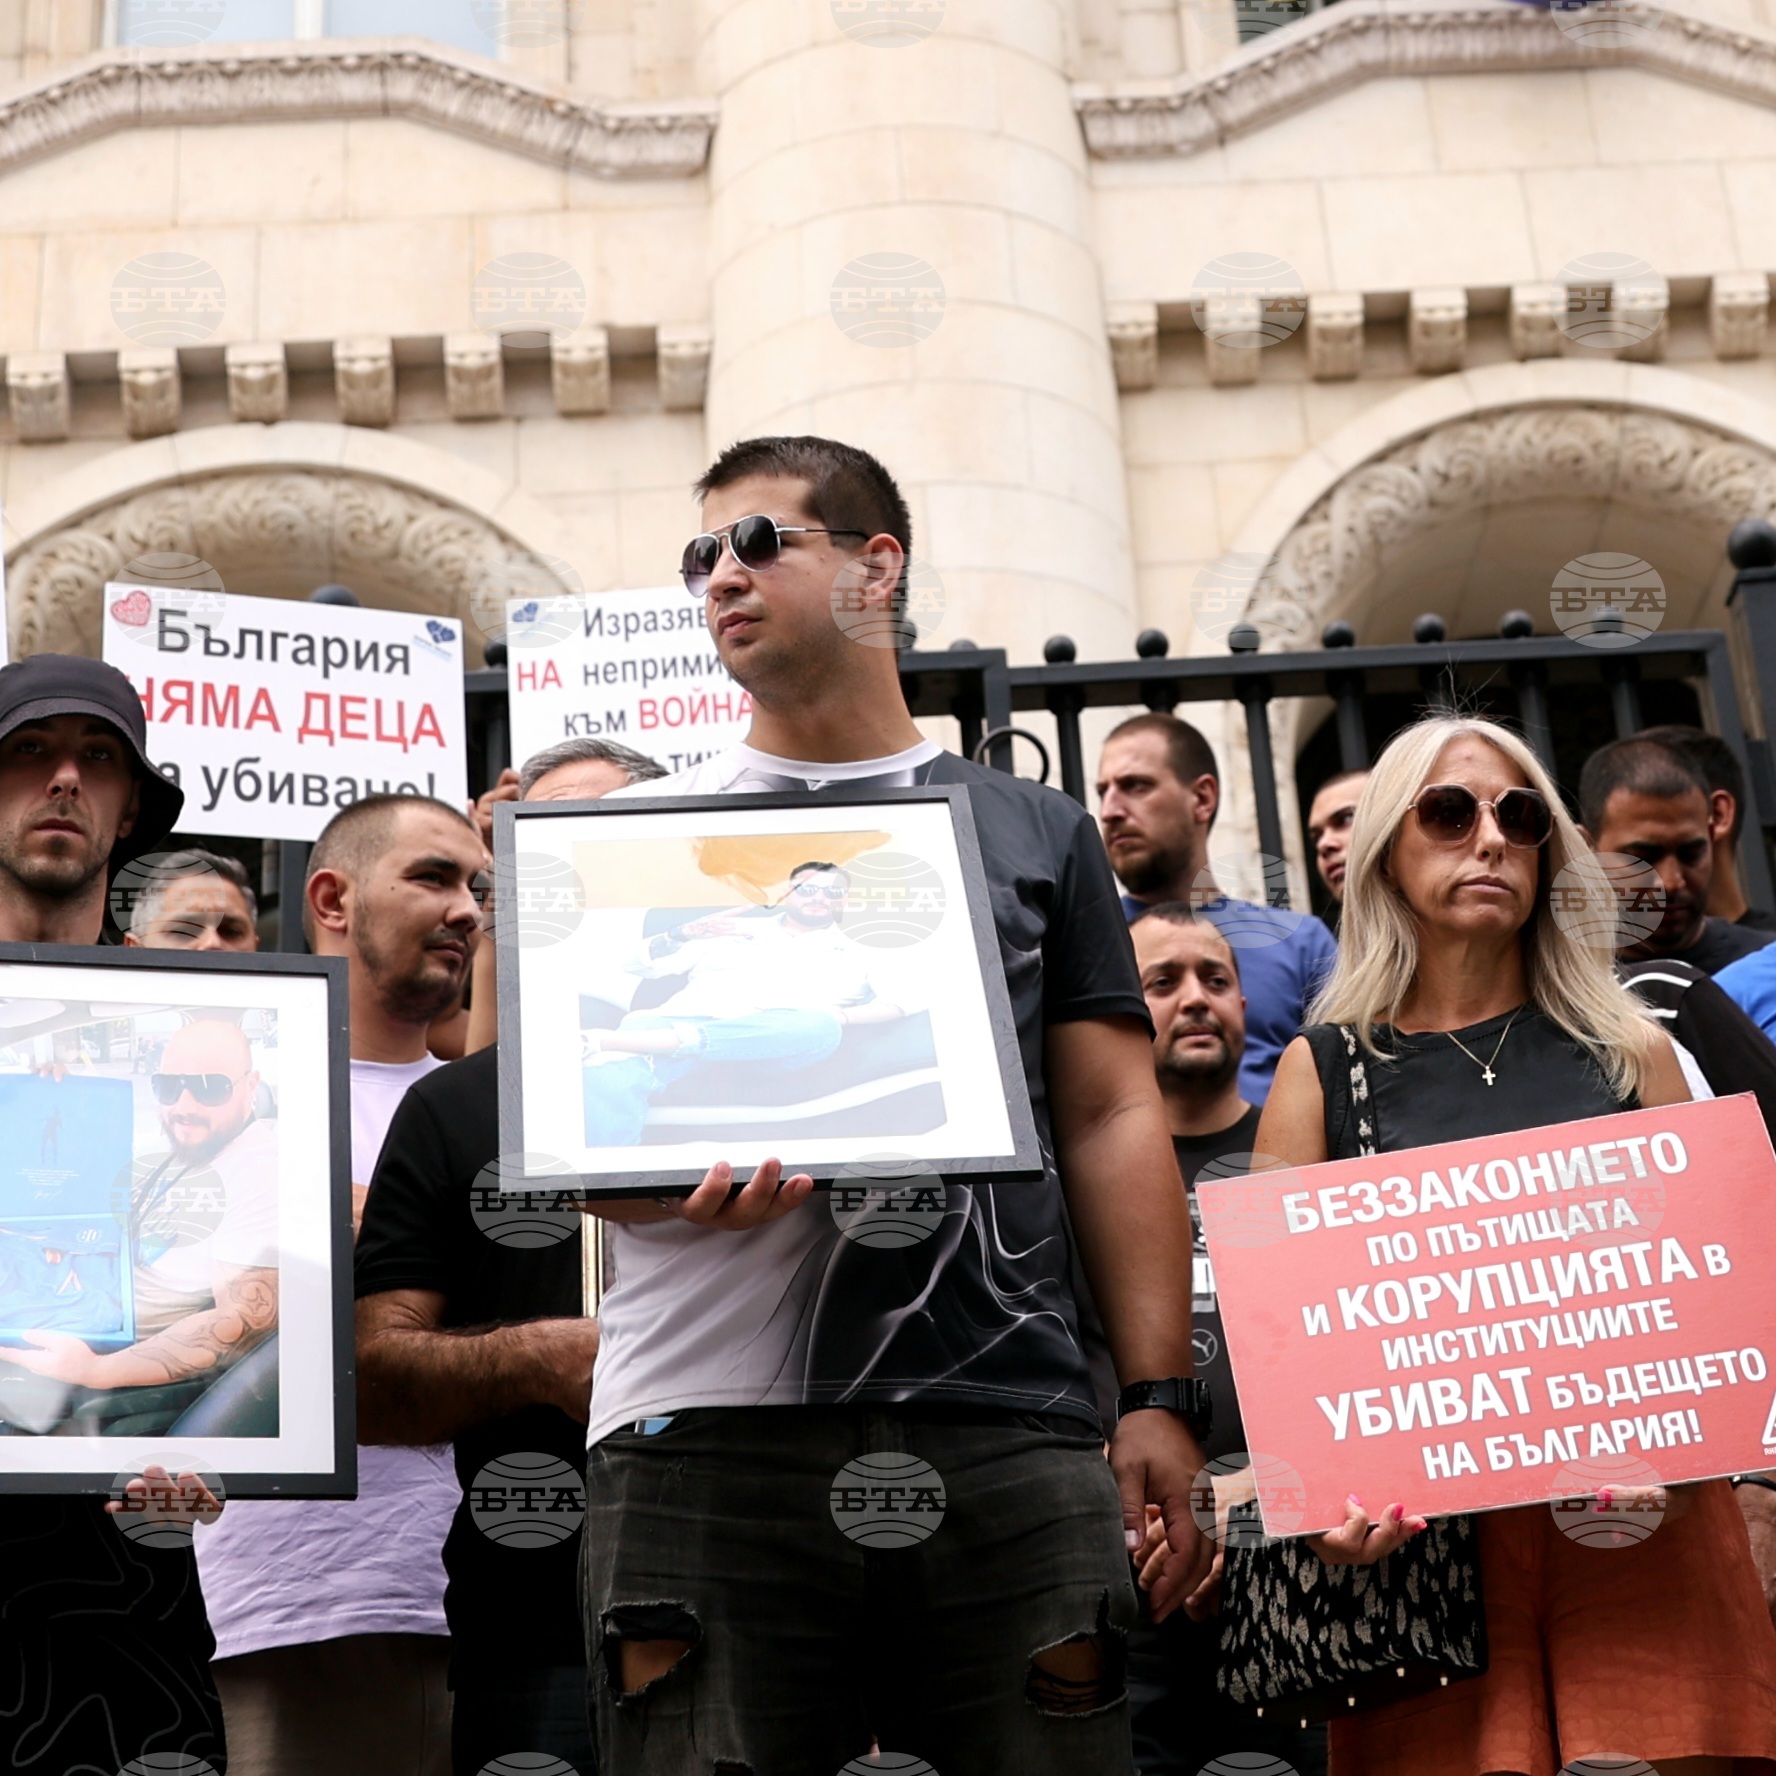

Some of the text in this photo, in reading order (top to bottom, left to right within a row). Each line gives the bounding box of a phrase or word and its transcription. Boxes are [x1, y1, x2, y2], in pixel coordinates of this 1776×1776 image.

[158, 607, 411, 680] България
[516, 653, 734, 693] НА неприми
[297, 690, 447, 754] ДЕЦА
[564, 709, 627, 738] към
[1281, 1131, 1688, 1234] БЕЗЗАКОНИЕТО
[1366, 1198, 1639, 1266] ПО ПЪТИЩАТА
[1337, 1237, 1698, 1326] КОРУПЦИЯТА
[1380, 1297, 1678, 1371] ИНСТИТУЦИИТЕ
[1316, 1346, 1768, 1441] УБИВАТ БЪДЕЩЕТО
[1422, 1408, 1703, 1481] НА БЪЛГАРИЯ!
